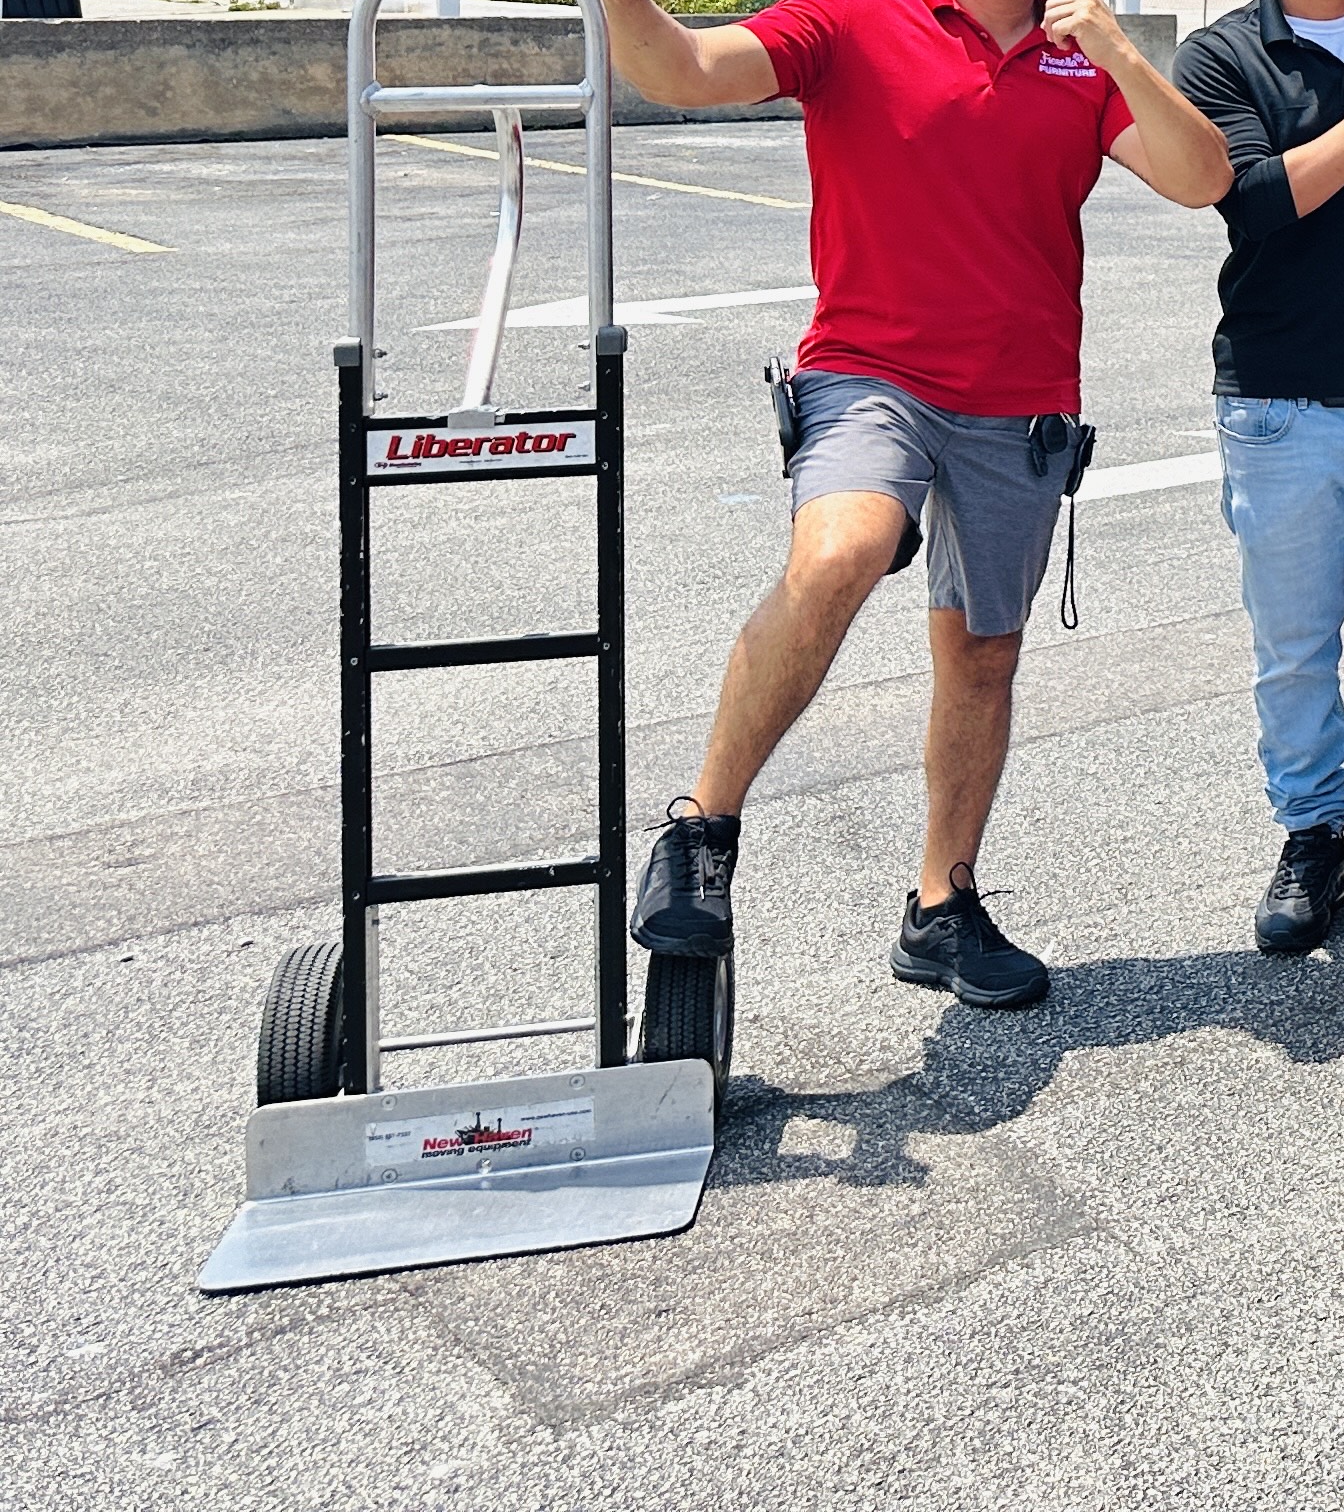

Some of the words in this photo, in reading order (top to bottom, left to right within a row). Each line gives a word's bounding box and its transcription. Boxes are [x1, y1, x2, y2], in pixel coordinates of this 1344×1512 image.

[1039, 65, 1096, 77] FURNITURE
[387, 431, 576, 460] Liberator
[421, 1147, 465, 1159] moving
[467, 1138, 533, 1154] equipment
[423, 1137, 463, 1151] New
